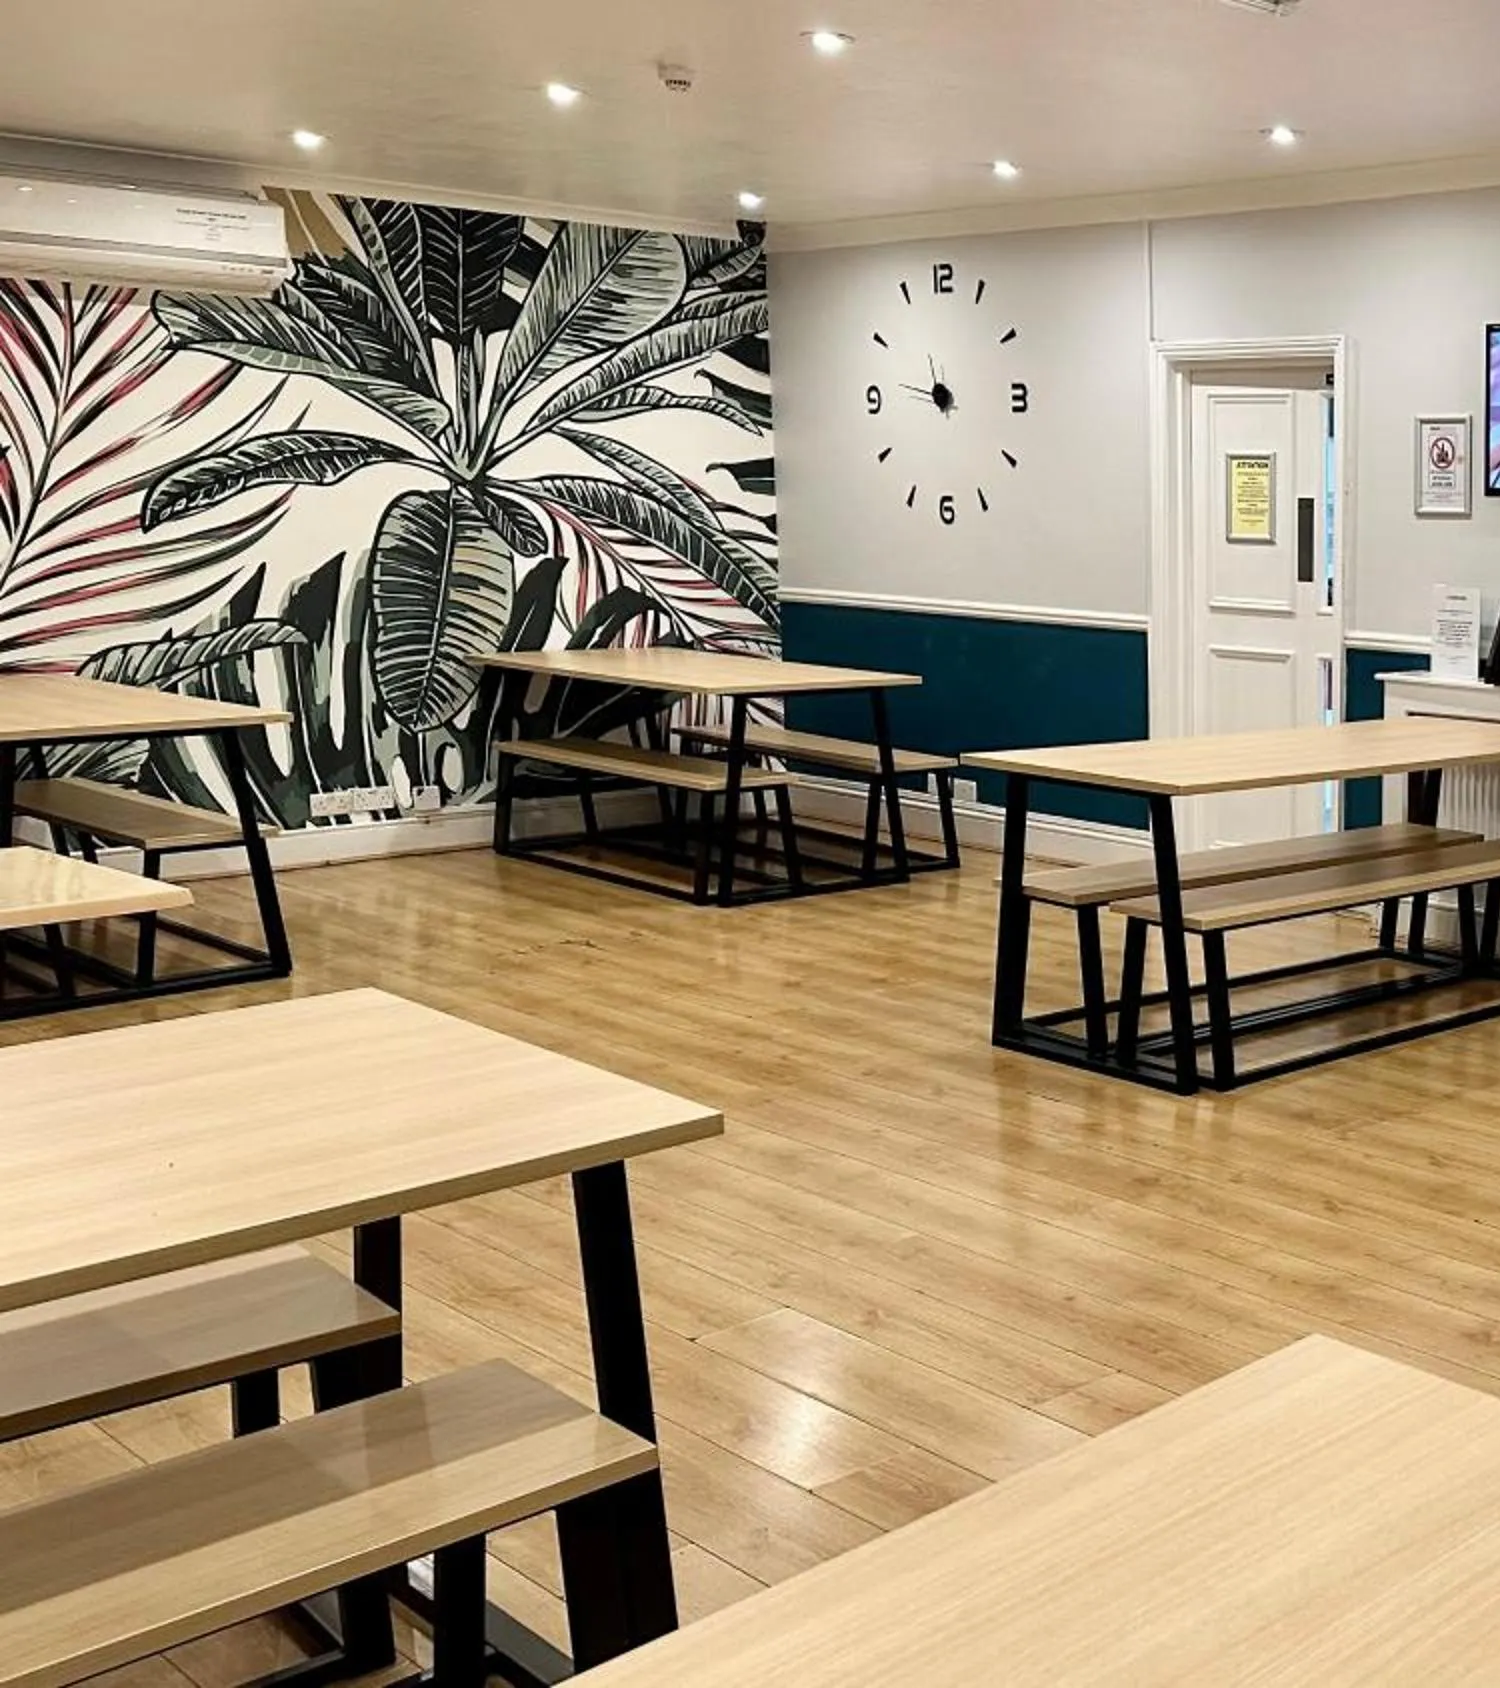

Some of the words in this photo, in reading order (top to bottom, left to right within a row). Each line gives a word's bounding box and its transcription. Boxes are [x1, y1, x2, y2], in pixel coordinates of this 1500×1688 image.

[933, 263, 954, 294] 12
[866, 384, 882, 414] 9
[1011, 383, 1029, 413] 3
[939, 495, 955, 525] 6
